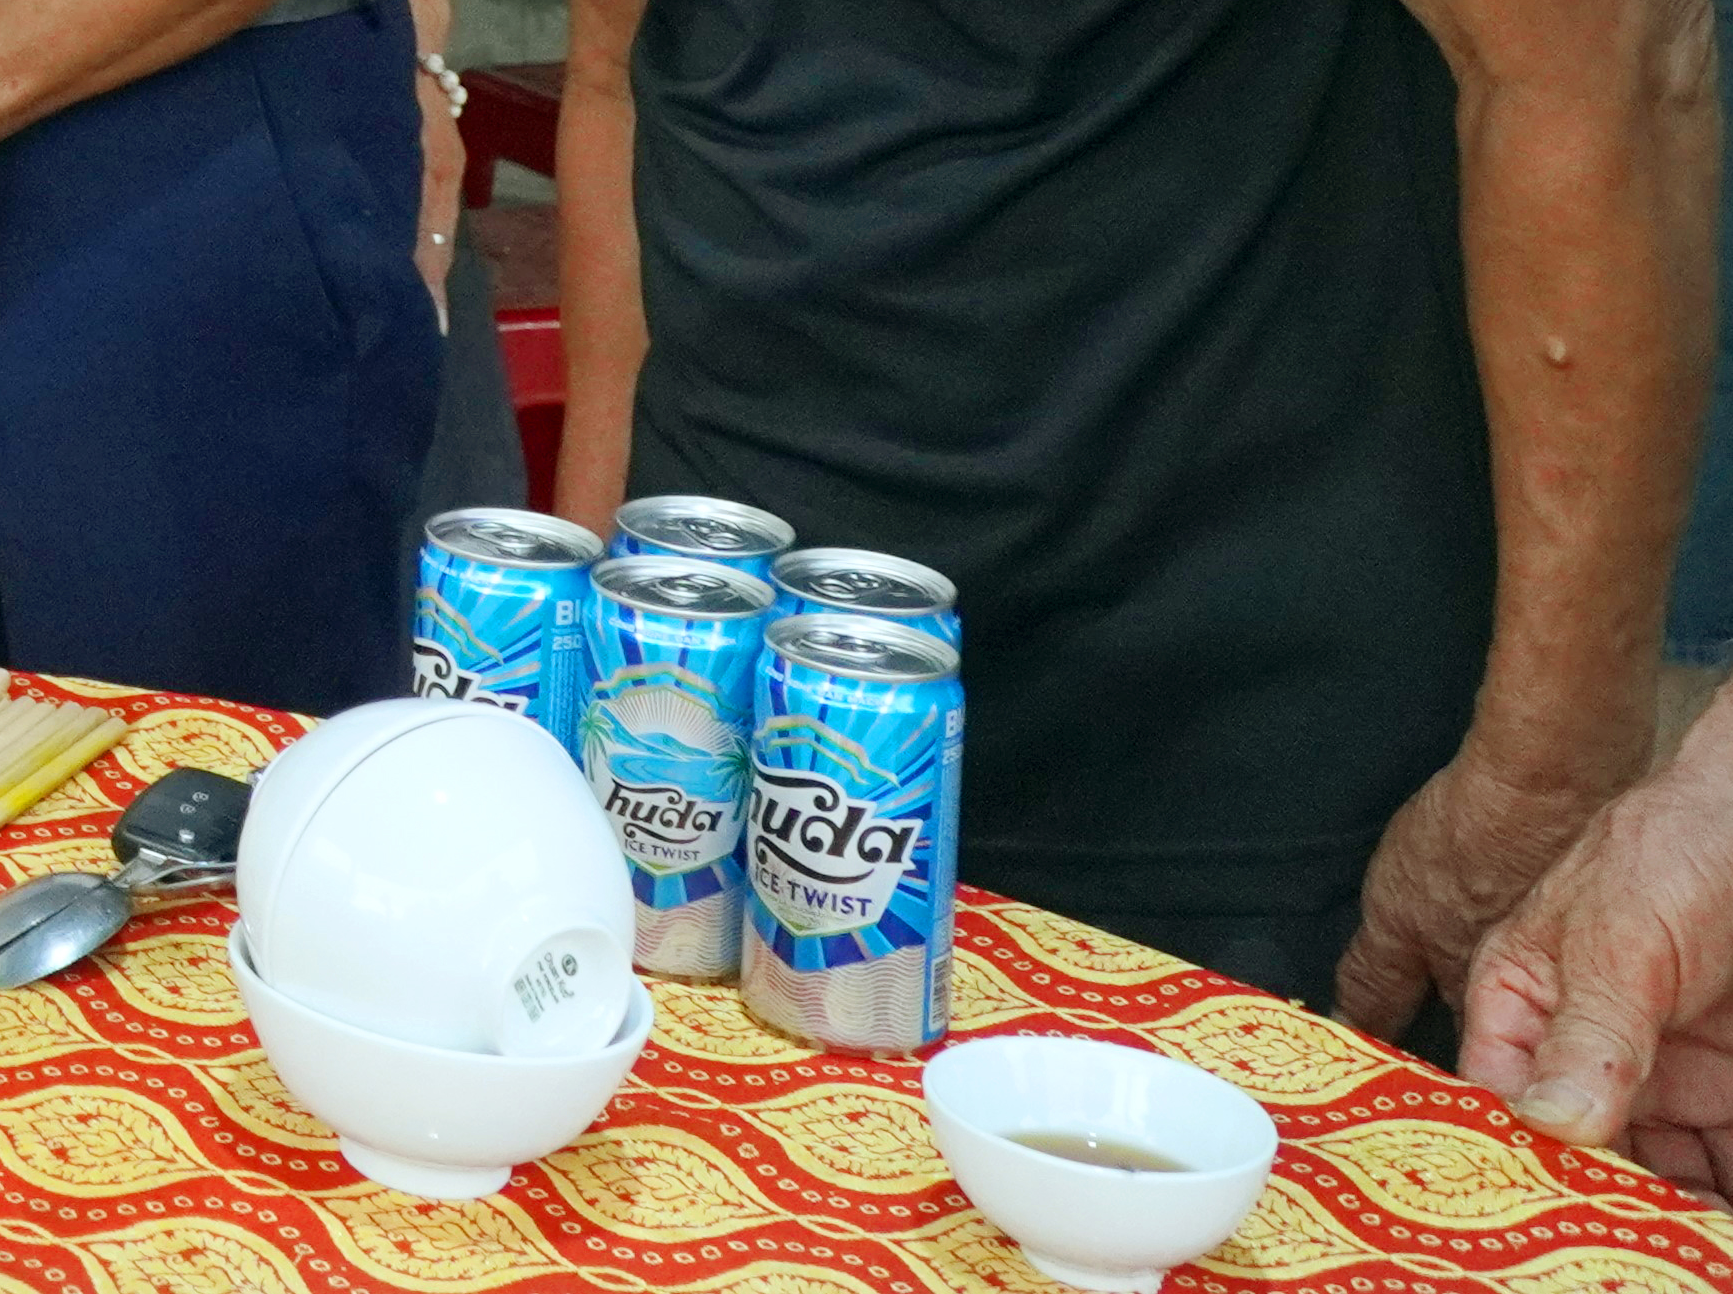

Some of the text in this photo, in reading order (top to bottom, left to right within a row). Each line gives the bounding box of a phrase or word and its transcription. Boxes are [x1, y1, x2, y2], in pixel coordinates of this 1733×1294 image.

[604, 778, 724, 833] huda
[624, 838, 701, 862] ICE TWIST
[787, 879, 873, 918] TWIST
